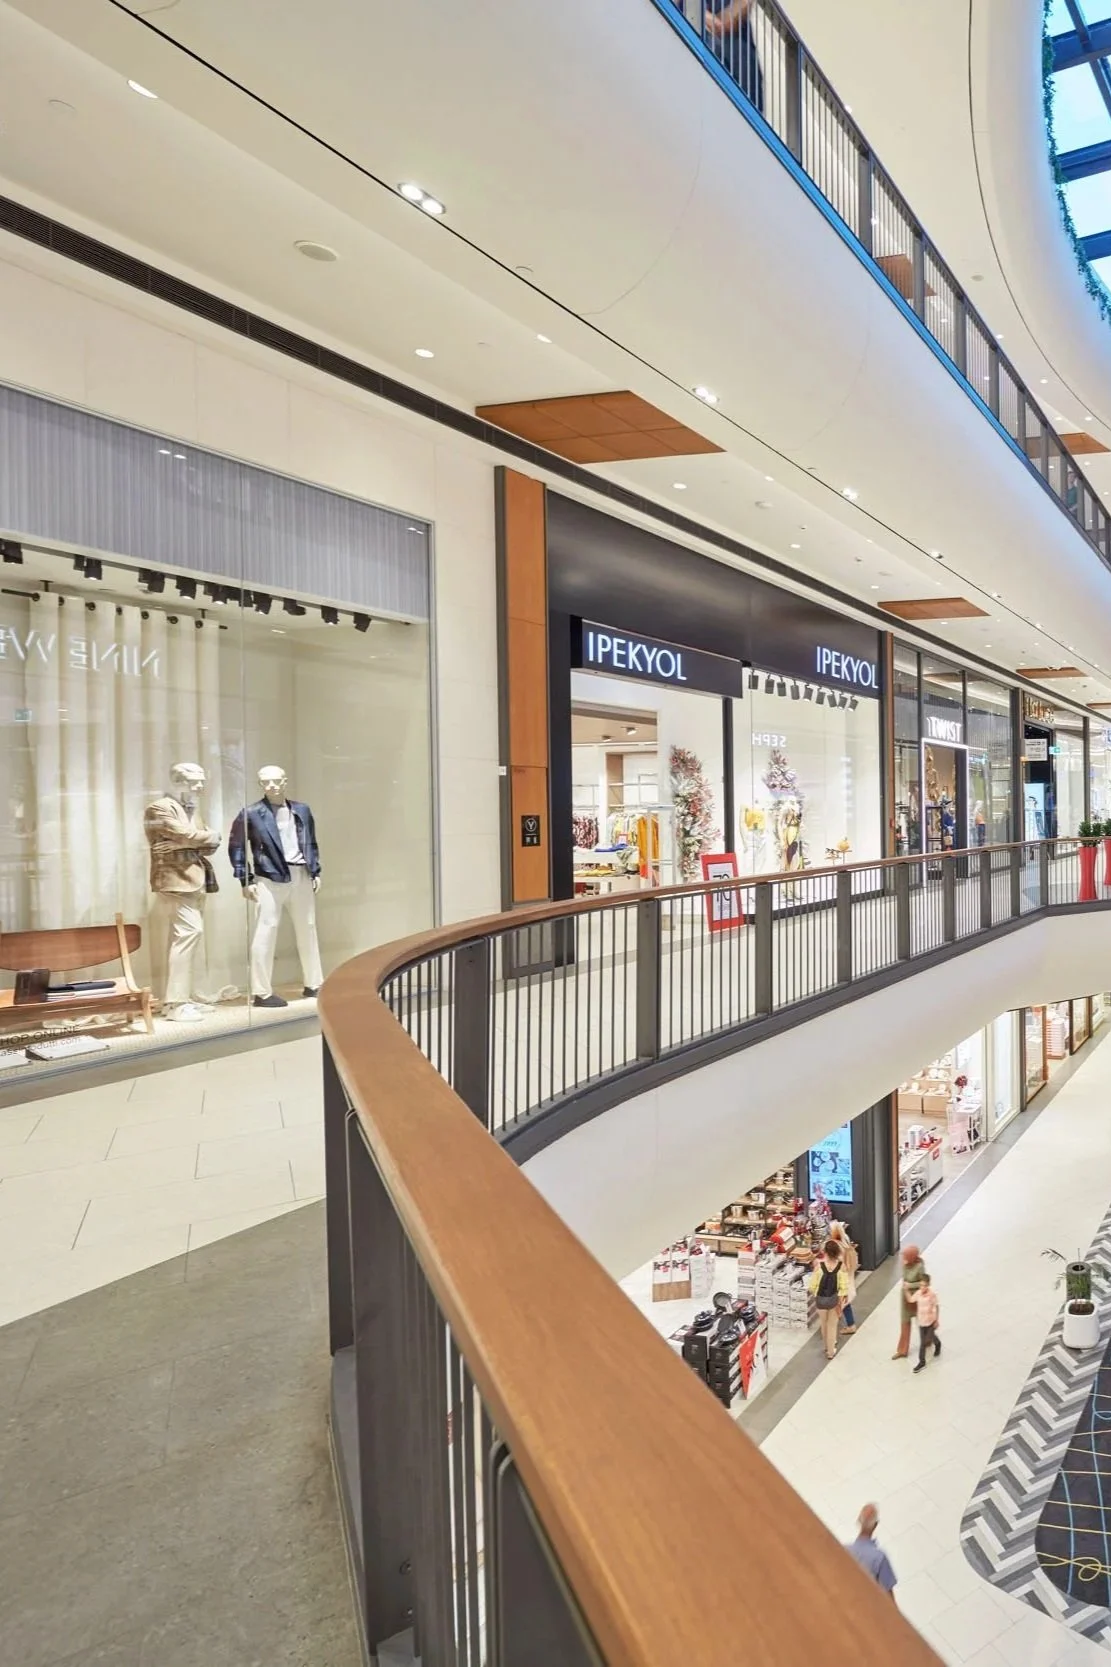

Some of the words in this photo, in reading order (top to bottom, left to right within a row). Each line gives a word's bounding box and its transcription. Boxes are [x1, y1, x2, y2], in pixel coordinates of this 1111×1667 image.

[587, 631, 687, 681] IPEKYOL
[816, 646, 879, 689] IPEKYOL
[33, 1024, 81, 1040] ONLINE
